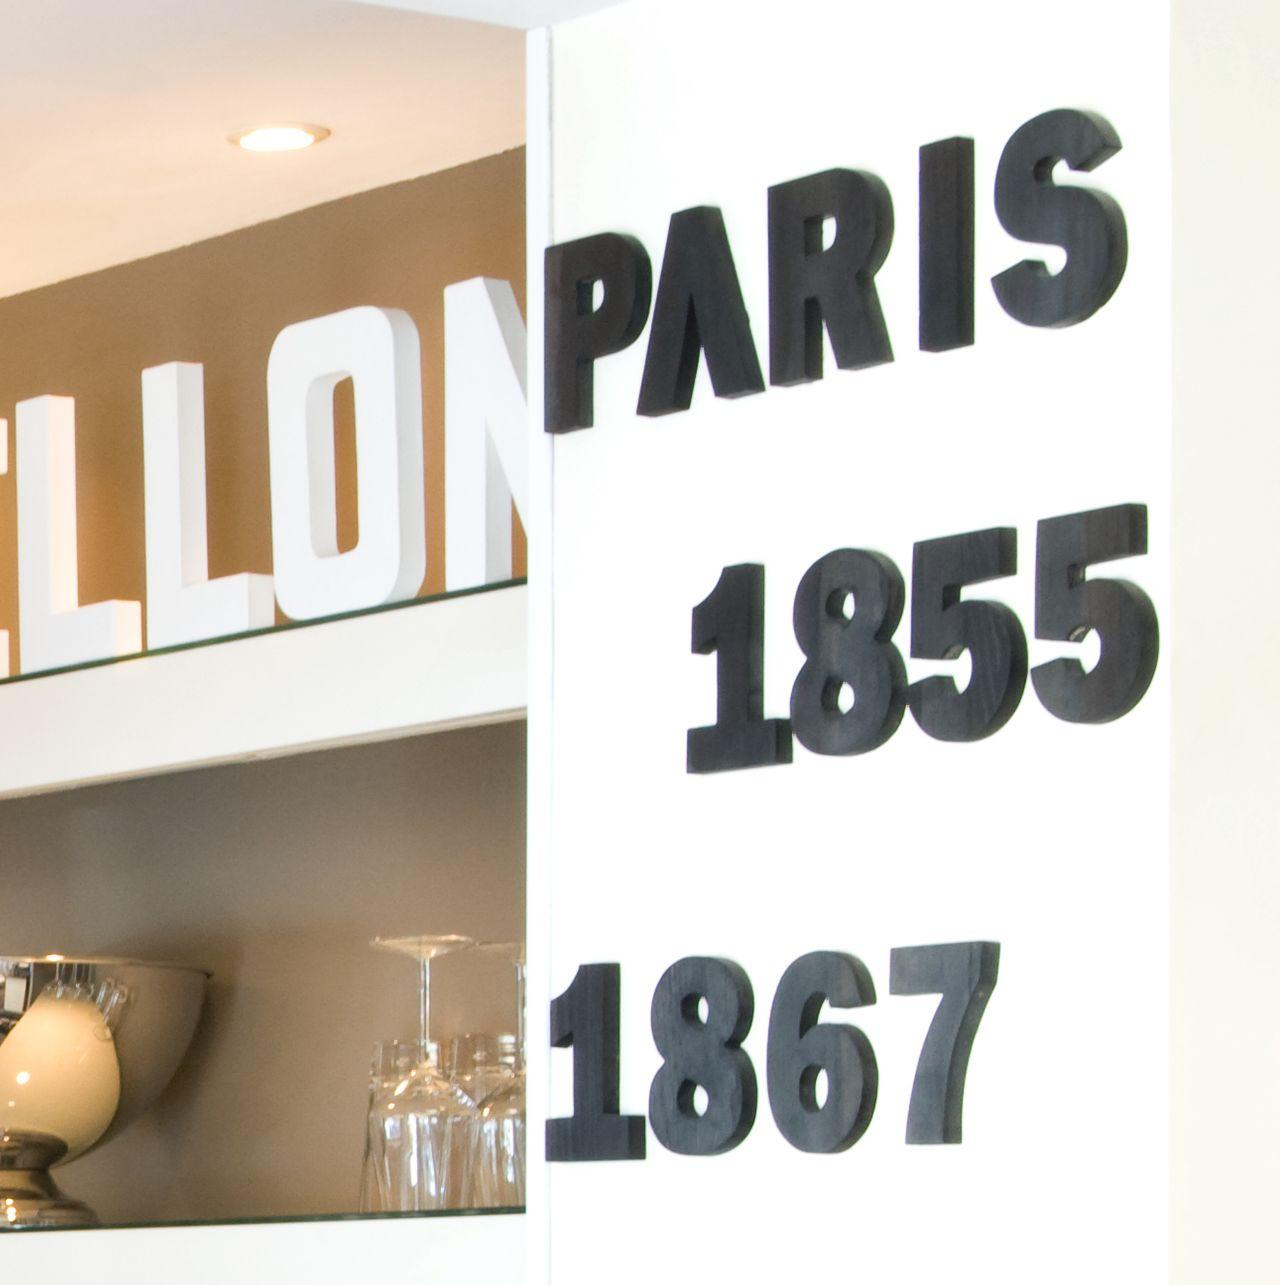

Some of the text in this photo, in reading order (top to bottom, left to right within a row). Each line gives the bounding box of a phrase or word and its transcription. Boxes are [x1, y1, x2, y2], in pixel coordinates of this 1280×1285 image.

[544, 107, 1129, 434] PARIS
[686, 502, 1160, 775] 1855
[545, 940, 1001, 1162] 1867
